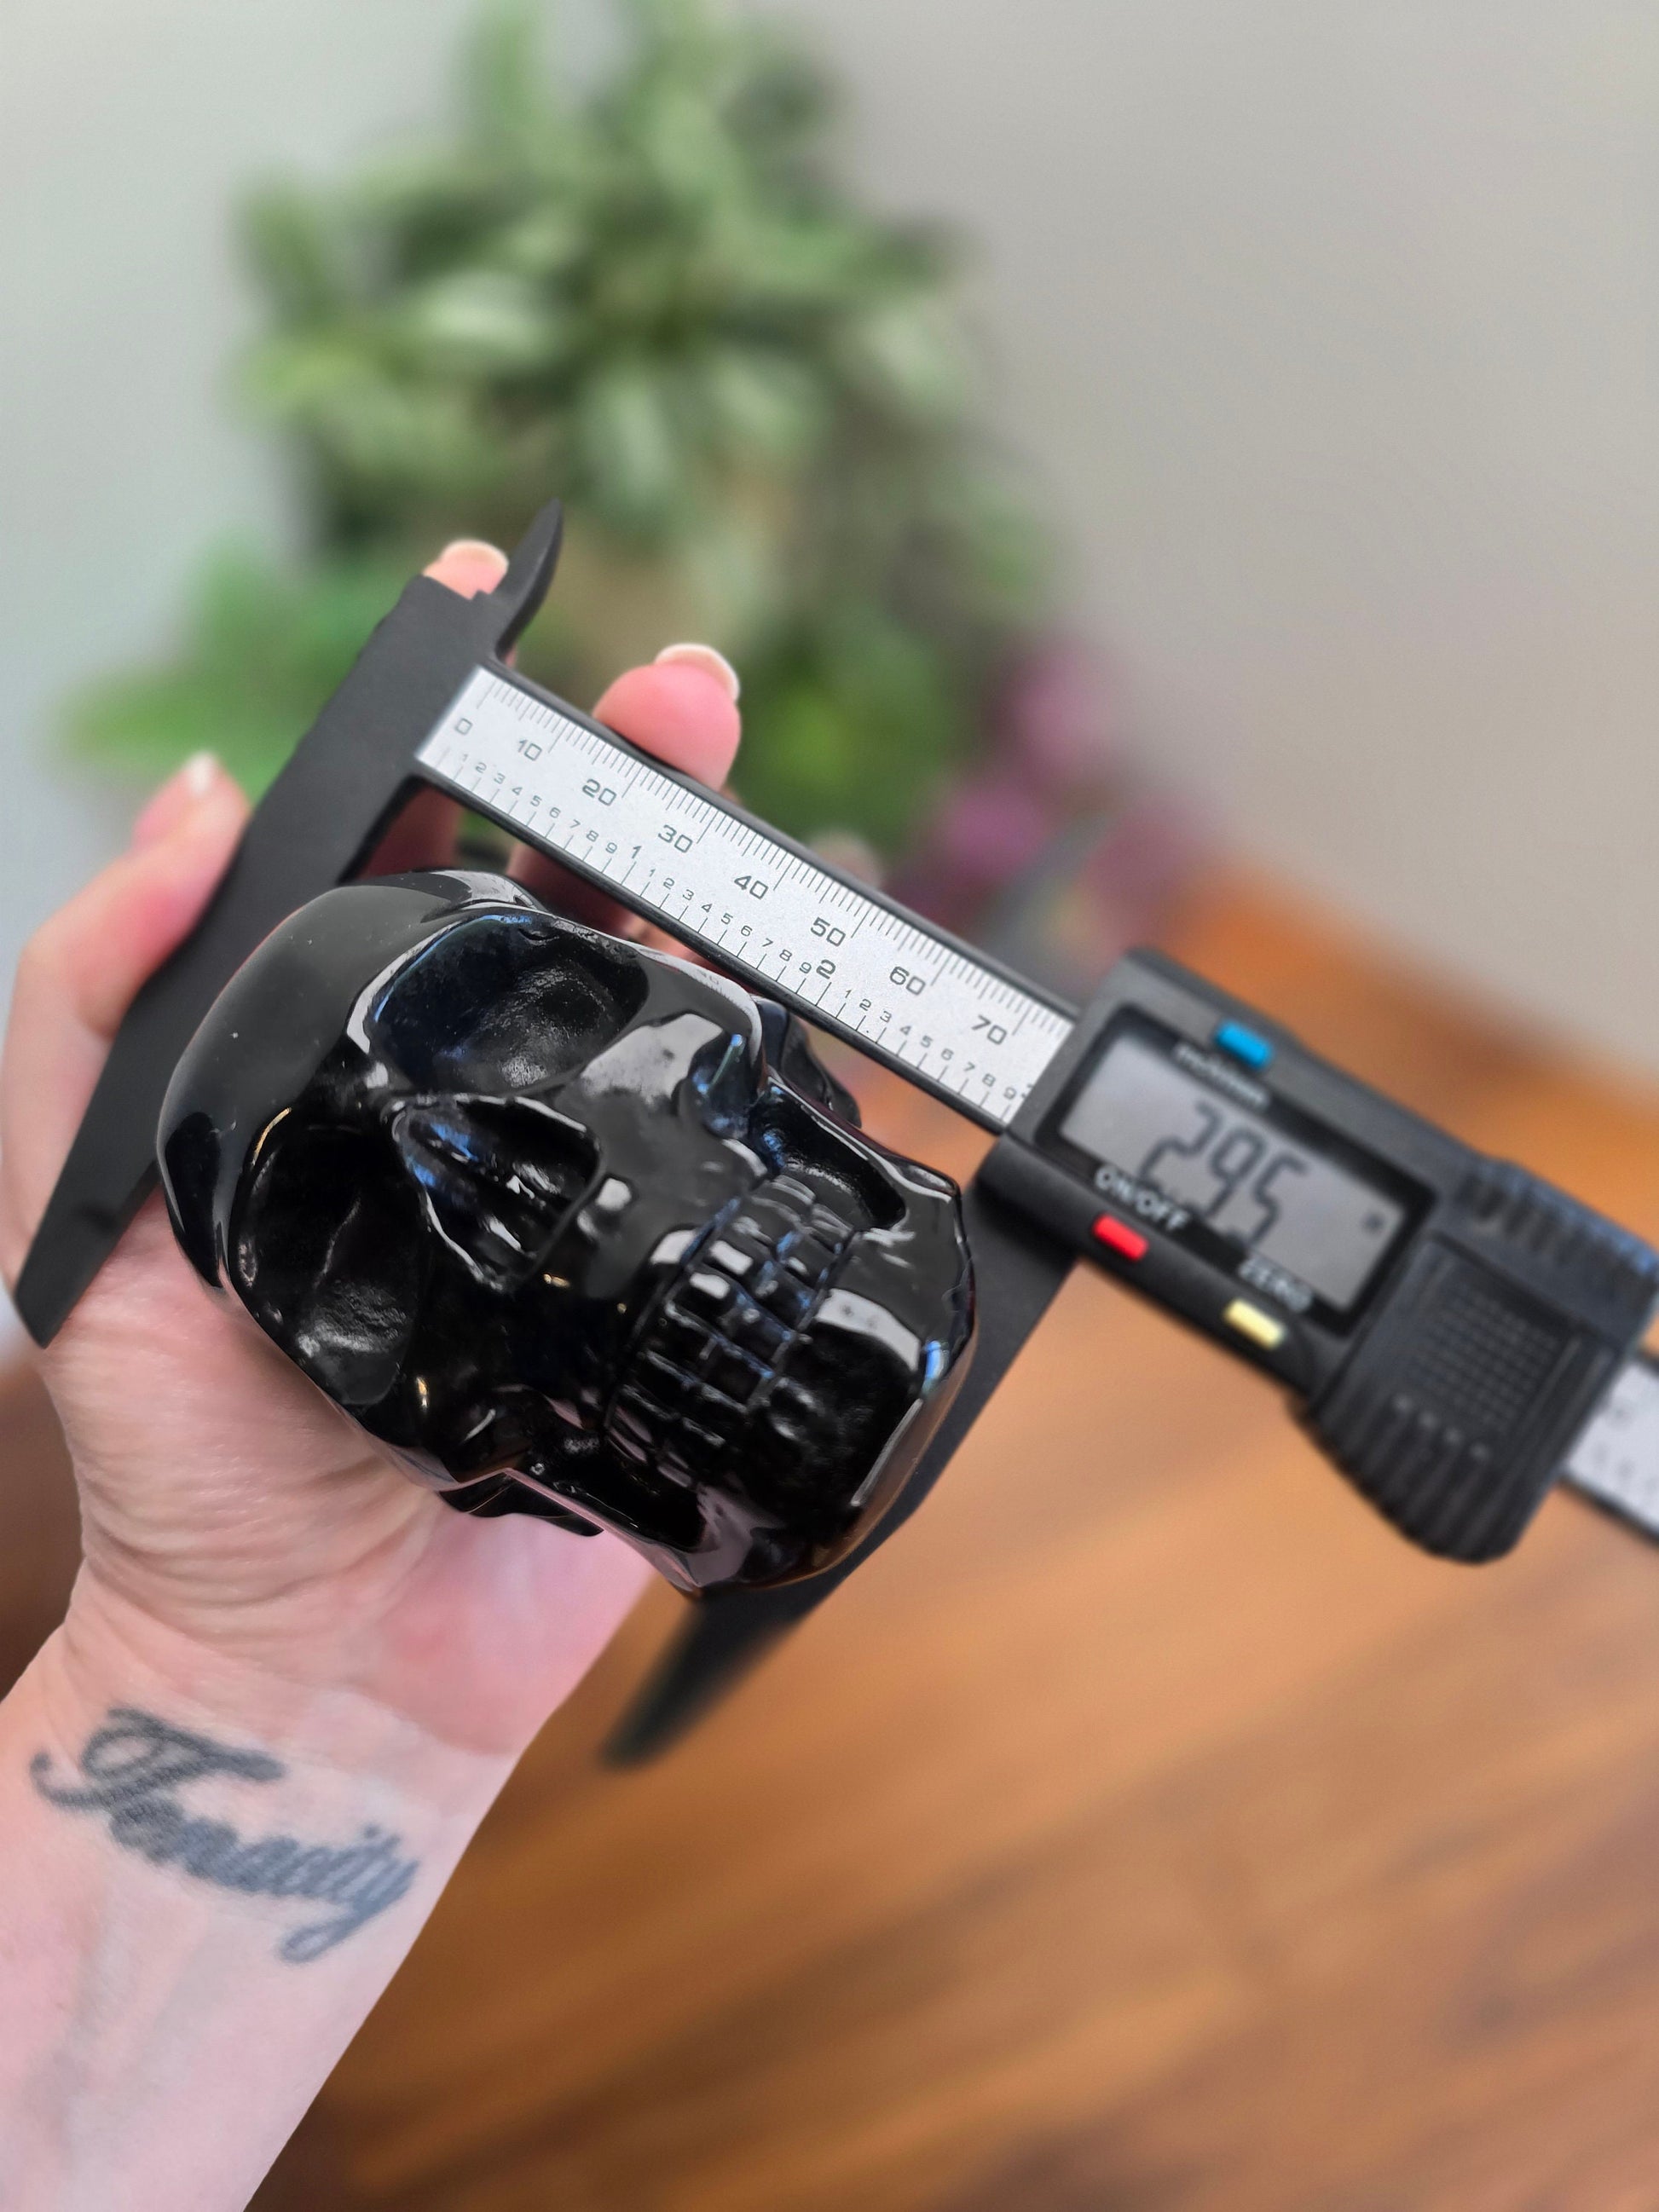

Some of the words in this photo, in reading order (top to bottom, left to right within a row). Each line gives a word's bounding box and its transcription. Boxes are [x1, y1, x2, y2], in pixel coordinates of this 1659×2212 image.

[454, 718, 473, 736] 0
[517, 739, 542, 761] 10
[582, 779, 617, 806] 20
[658, 824, 693, 853] 30
[734, 875, 769, 899] 40
[810, 917, 846, 947] 50
[888, 966, 926, 996] 60
[972, 1014, 1007, 1045] 70
[461, 753, 469, 762] 1
[475, 762, 487, 773] 2
[494, 773, 506, 784] 3
[512, 786, 523, 796] 4
[530, 795, 542, 807] 5
[549, 807, 561, 818] 6
[569, 819, 581, 829] 7
[586, 830, 599, 842] 8
[605, 842, 617, 854] 9
[632, 845, 642, 859] 1
[649, 868, 656, 877] 1
[663, 878, 674, 890] 2
[682, 889, 694, 901] 3
[701, 903, 713, 913] 4
[720, 913, 733, 925] 5
[740, 925, 753, 937] 6
[761, 938, 773, 947] 7
[779, 949, 793, 962] 8
[799, 962, 812, 974] 9
[816, 959, 836, 980] 2
[844, 989, 852, 999] 1
[858, 998, 871, 1011] 2
[880, 1011, 892, 1023] 3
[899, 1025, 911, 1036] 4
[920, 1035, 934, 1048] 5
[940, 1048, 954, 1060] 6
[963, 1061, 975, 1071] 7
[982, 1073, 996, 1087] 8
[1003, 1087, 1016, 1100] 9
